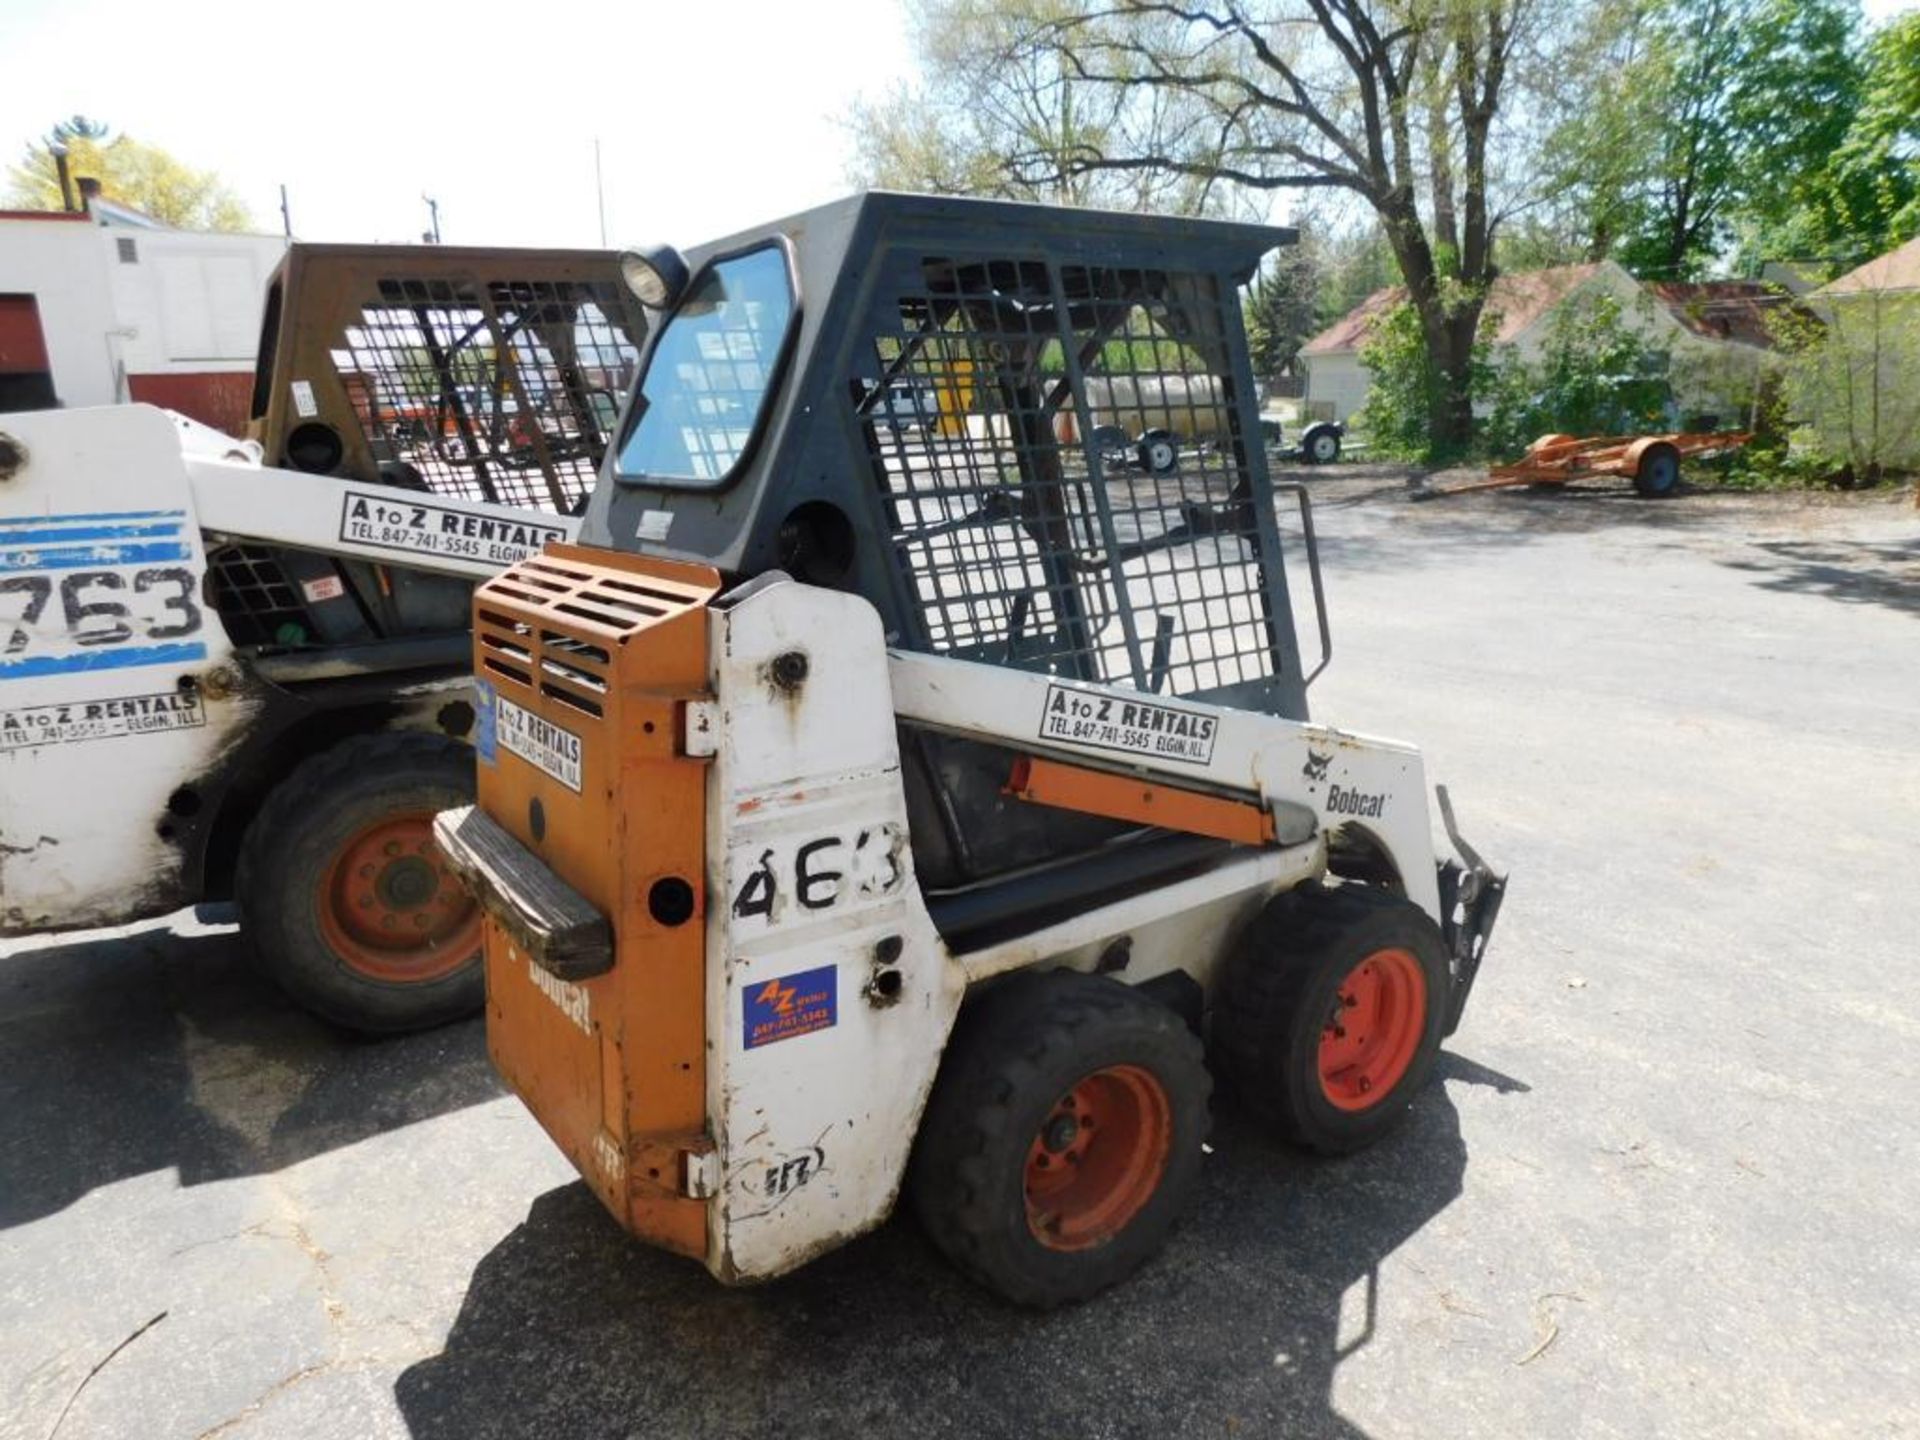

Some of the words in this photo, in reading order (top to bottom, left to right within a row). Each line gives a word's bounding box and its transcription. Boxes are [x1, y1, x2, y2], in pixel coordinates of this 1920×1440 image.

[352, 499, 369, 519] A
[376, 507, 402, 525] to
[409, 509, 427, 528] Z
[382, 529, 480, 555] 847-741-5545
[0, 566, 203, 653] 763
[4, 712, 21, 729] A
[24, 714, 51, 727] to
[56, 707, 72, 723] Z
[84, 694, 197, 720] RENTALS
[1052, 691, 1066, 715] A
[1071, 698, 1092, 718] to
[1097, 700, 1112, 721] Z
[1121, 704, 1212, 740] RENTALS
[527, 714, 578, 764] RENTALS
[1073, 721, 1150, 749] 847-741-5545
[1326, 784, 1385, 819] Bobcat
